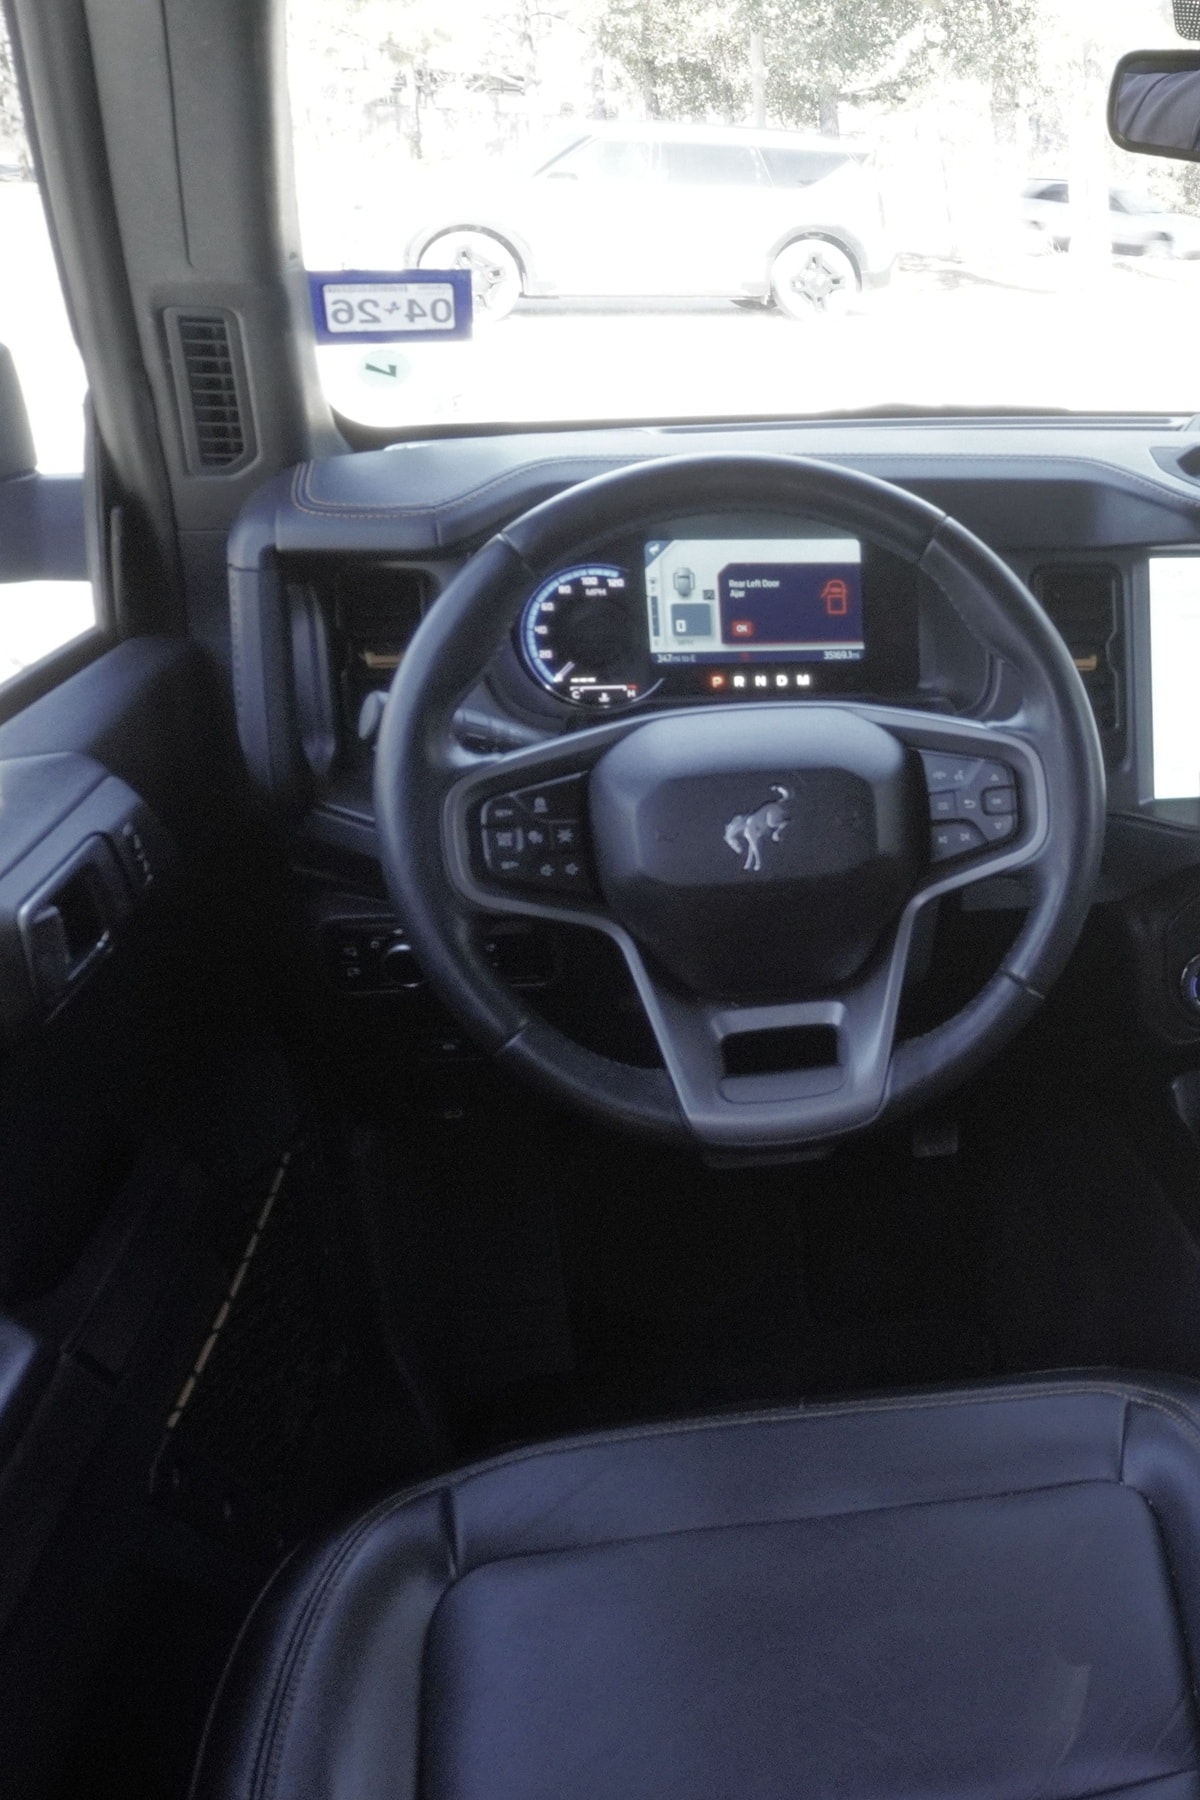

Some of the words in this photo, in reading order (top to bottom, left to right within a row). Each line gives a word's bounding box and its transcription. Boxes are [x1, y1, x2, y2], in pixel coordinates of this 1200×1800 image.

[729, 579, 746, 588] Rear
[747, 578, 762, 588] Left
[762, 579, 780, 588] Door
[729, 589, 746, 599] Ajar
[539, 649, 553, 659] 20
[712, 676, 723, 687] P
[734, 675, 745, 687] R
[755, 675, 767, 687] N
[777, 675, 788, 686] D
[796, 674, 810, 686] M
